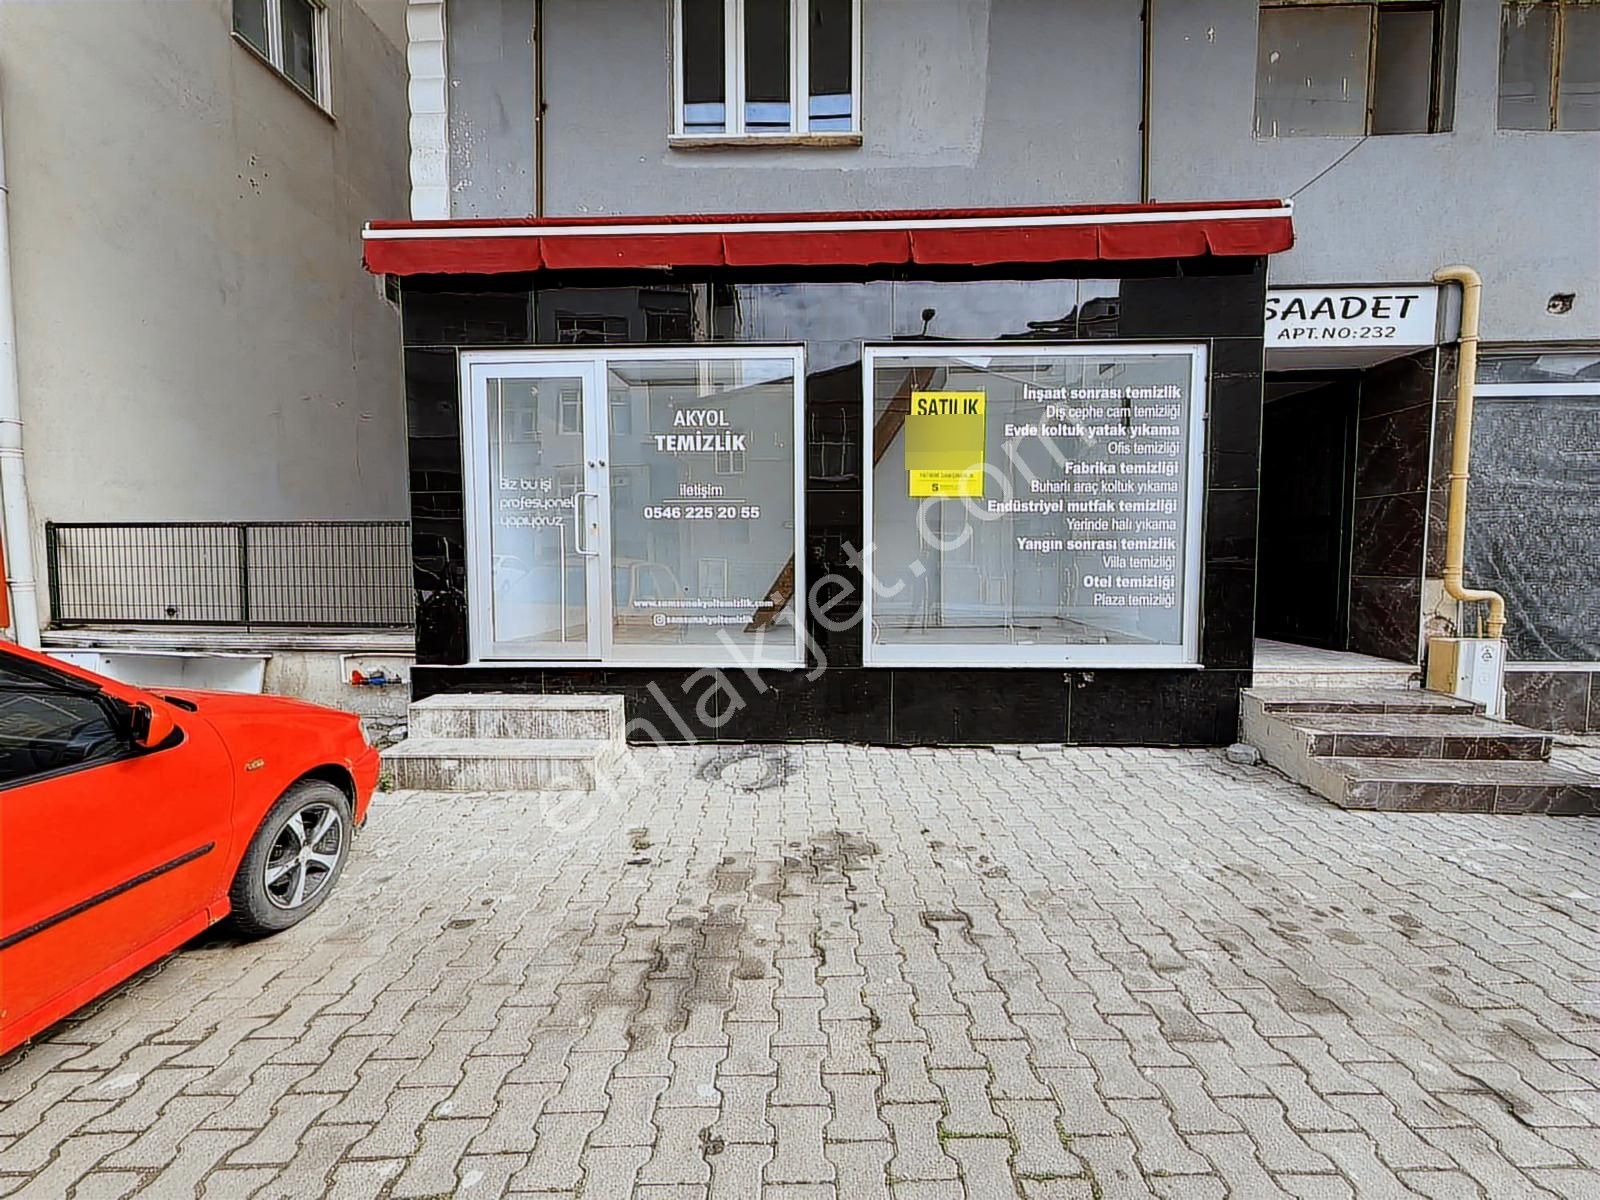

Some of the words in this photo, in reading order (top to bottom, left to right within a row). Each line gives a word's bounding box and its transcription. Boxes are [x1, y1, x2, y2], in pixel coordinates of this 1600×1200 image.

[1265, 295, 1419, 321] SAADET
[1023, 384, 1067, 402] İnşaat
[1070, 387, 1122, 399] sonrası
[1125, 385, 1182, 399] temizlik
[673, 410, 730, 426] AKYOL
[1068, 405, 1104, 421] cephe
[1106, 407, 1131, 418] cam
[1133, 404, 1181, 420] temizliği
[1004, 424, 1038, 437] Evde
[1041, 424, 1085, 437] koltuk
[1087, 423, 1127, 439] yatak
[1128, 423, 1180, 439] yıkama
[654, 431, 747, 451] TEMİZLİK
[1107, 442, 1132, 454] Ofis
[1133, 441, 1180, 458] temizliği
[1064, 461, 1117, 475] Fabrika
[1119, 461, 1179, 478] temizliği
[1030, 480, 1072, 493] Buharlı
[1073, 482, 1099, 496] araç
[1101, 480, 1135, 493] koltuk
[1136, 480, 1178, 496] yıkama
[644, 507, 681, 519] 0546
[685, 507, 713, 519] 225
[717, 507, 736, 519] 20
[741, 507, 760, 519] 55
[988, 500, 1063, 515] Endüstriyel
[1067, 500, 1116, 512] mutfak
[1119, 500, 1177, 515] temizliği
[1066, 518, 1109, 531] Yerinde
[1111, 518, 1133, 531] halı
[1135, 518, 1176, 533] yıkama
[1066, 538, 1117, 550] sonrası
[1120, 537, 1176, 550] temizlik
[1103, 555, 1127, 568] Villa
[1129, 555, 1175, 571] temizliği
[1084, 575, 1112, 588] Otel
[1115, 575, 1175, 591] temizliği
[1094, 594, 1126, 606] Plaza
[1128, 593, 1175, 610] temizliği
